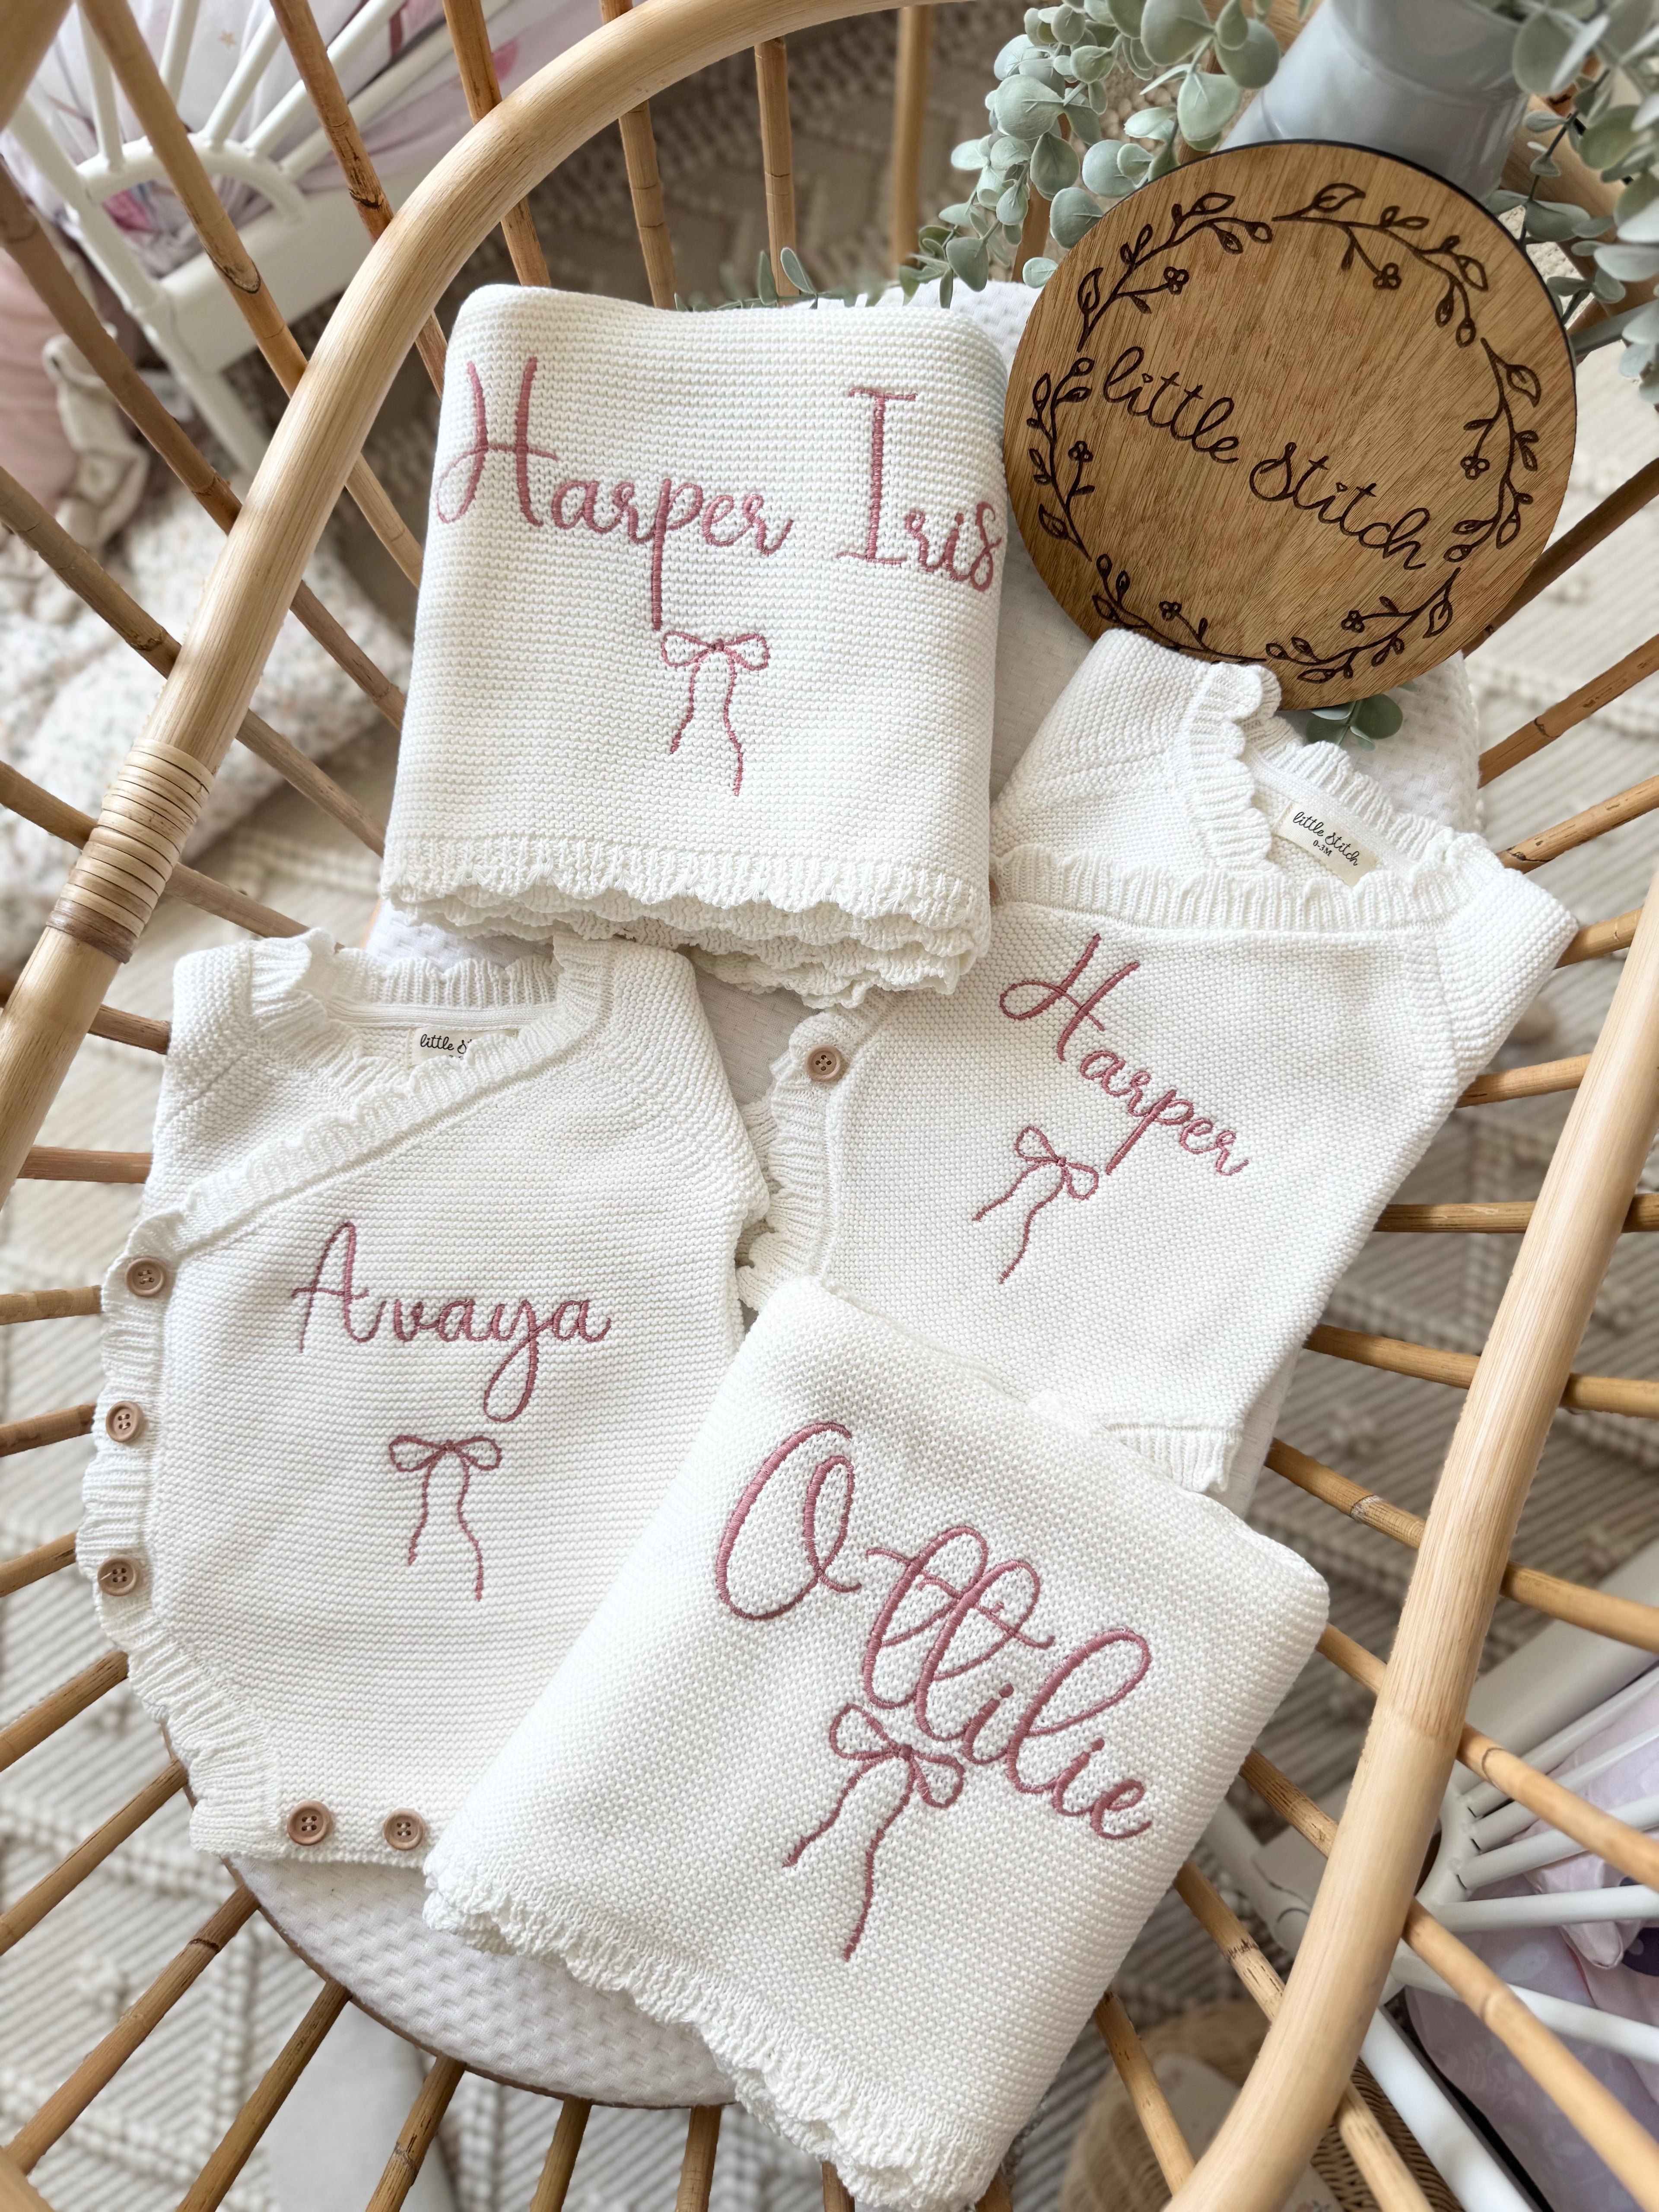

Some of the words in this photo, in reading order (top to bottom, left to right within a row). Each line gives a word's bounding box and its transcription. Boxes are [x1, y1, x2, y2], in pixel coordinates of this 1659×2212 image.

[1102, 346, 1239, 464] little
[436, 356, 793, 632] Harper
[836, 388, 1002, 592] Iris
[1293, 811, 1324, 837] little
[1312, 839, 1332, 857] 0-3M
[420, 1034, 454, 1051] little
[999, 933, 1249, 1176] Harper
[291, 1221, 611, 1423] Avaya
[715, 1421, 1152, 1840] Ottilie
